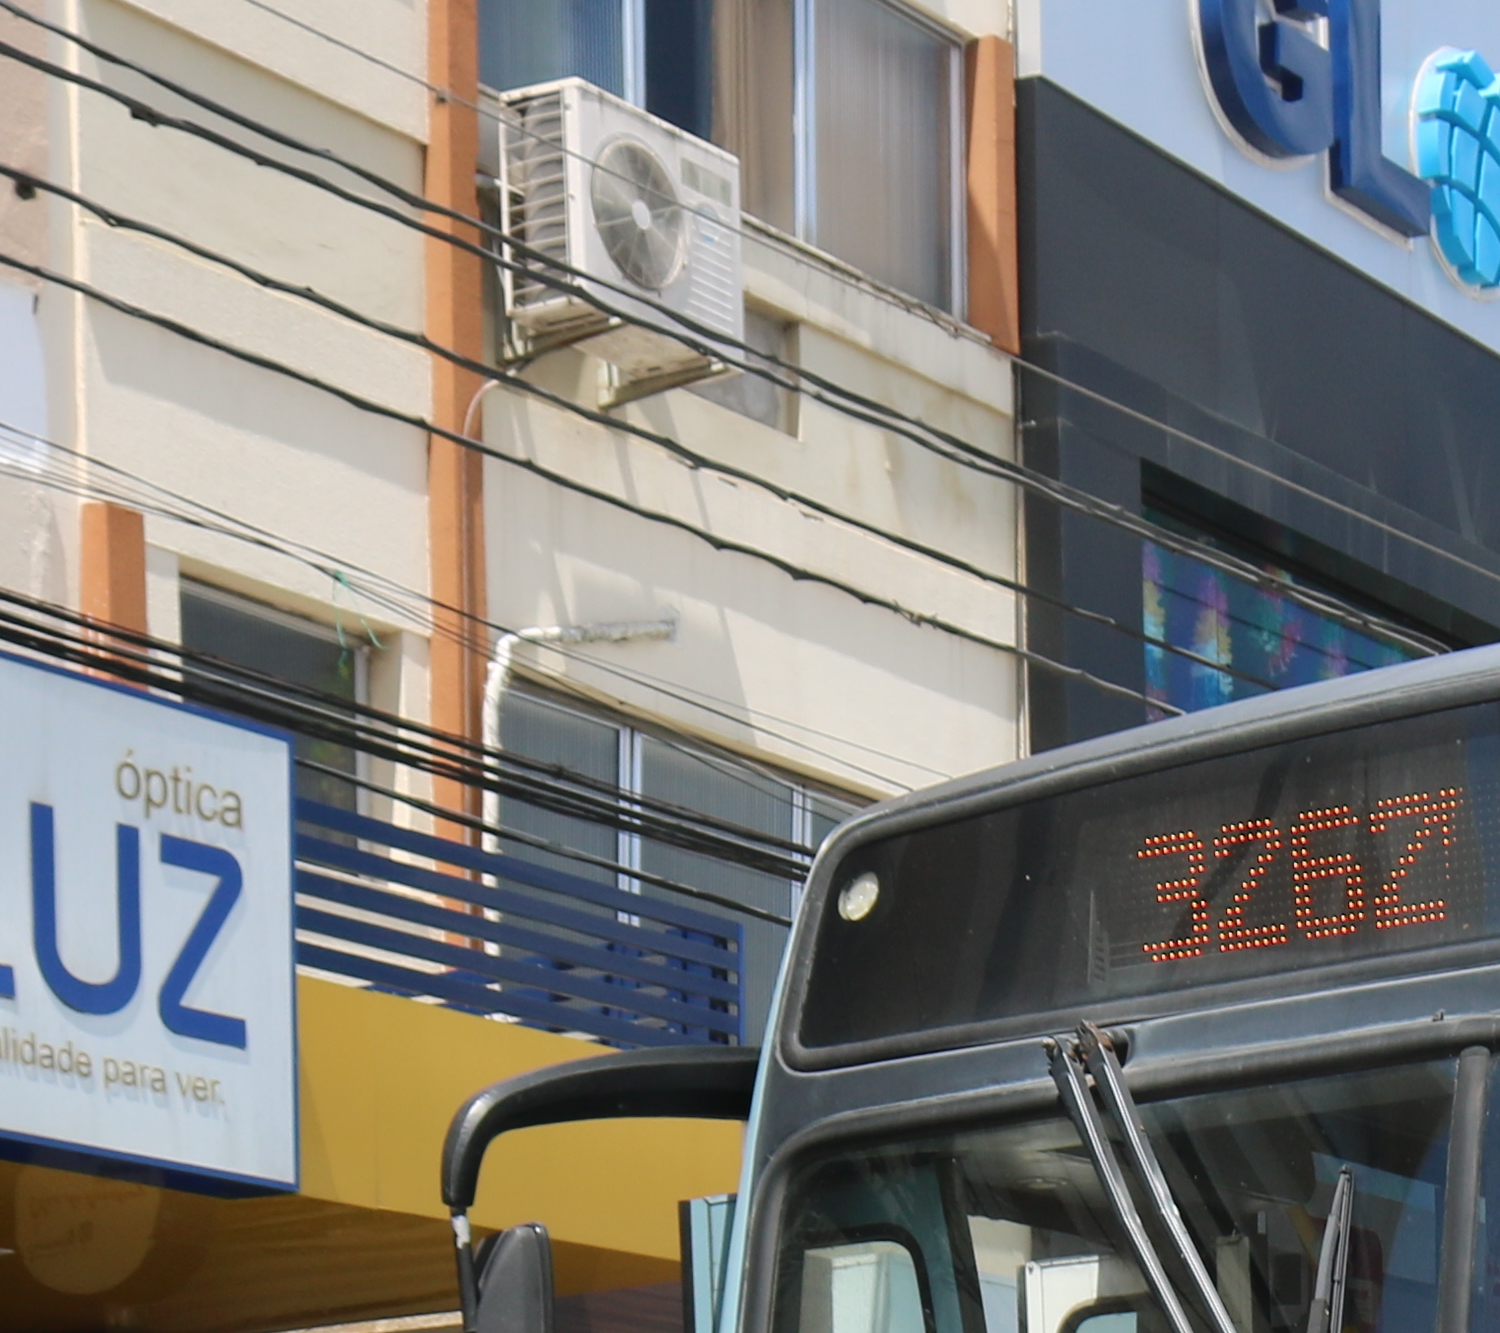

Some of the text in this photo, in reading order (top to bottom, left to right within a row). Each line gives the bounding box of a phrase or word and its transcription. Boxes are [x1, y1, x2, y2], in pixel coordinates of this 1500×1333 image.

[114, 748, 245, 831] óptica
[1136, 784, 1460, 964] 3262
[103, 1058, 167, 1100] para
[176, 1072, 226, 1106] ver.
